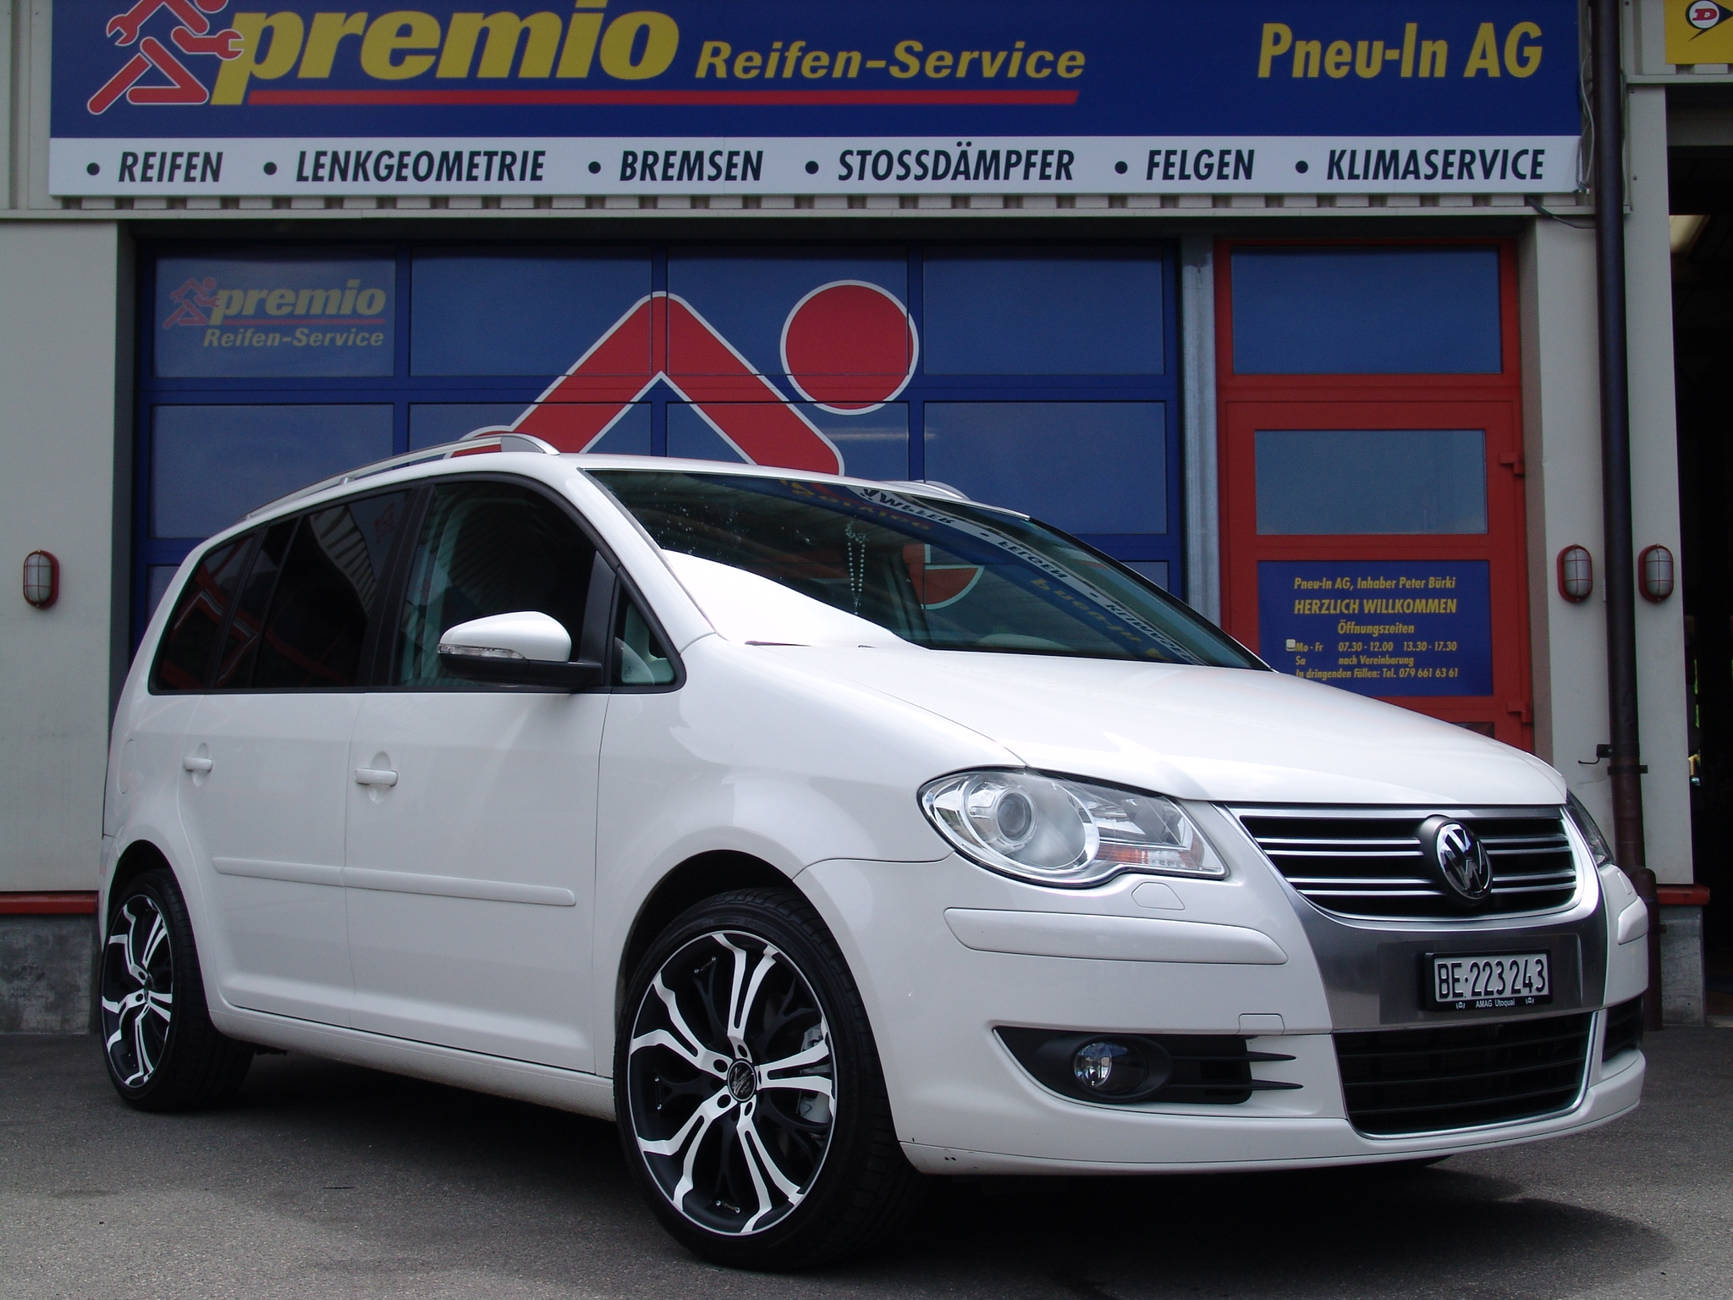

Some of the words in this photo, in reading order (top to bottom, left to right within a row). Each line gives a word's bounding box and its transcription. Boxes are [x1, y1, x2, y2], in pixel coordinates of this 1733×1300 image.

[211, 0, 680, 105] premio
[695, 40, 1087, 80] Reifen-Service
[1257, 22, 1448, 79] Pneu-In
[1463, 21, 1544, 79] AG
[118, 151, 224, 184] REIFEN
[295, 150, 547, 183] LENKGEOMETRIE
[619, 150, 764, 182] BREMSEN
[837, 141, 1076, 182] STOSSDÄMPFER
[1145, 149, 1256, 181] FELGEN
[1326, 148, 1546, 181] KLIMASERVICE
[209, 279, 387, 326] premio
[203, 327, 385, 348] Reifen-Service
[1294, 577, 1332, 590] Pneu-In
[1335, 577, 1354, 591] AG,
[1357, 576, 1396, 589] Inhaber
[1399, 577, 1426, 589] Peter
[1294, 599, 1360, 614] HERZLICH
[1363, 598, 1458, 614] WILLKOMMEN
[1338, 619, 1415, 637] Öffnungszeiten
[1315, 642, 1324, 652] Fr
[1338, 641, 1363, 652] 07.30
[1370, 641, 1394, 652] 12.00
[1404, 641, 1428, 652] 13.30
[1435, 641, 1458, 652] 17.30
[1338, 654, 1358, 665] nach
[1360, 654, 1415, 667] Vereinbarung
[1305, 667, 1352, 681] dringenden
[1383, 667, 1397, 678] Tel.
[1399, 667, 1416, 678] 079
[1417, 667, 1433, 678] 661
[1435, 667, 1447, 678] 63
[1448, 667, 1459, 678] 61
